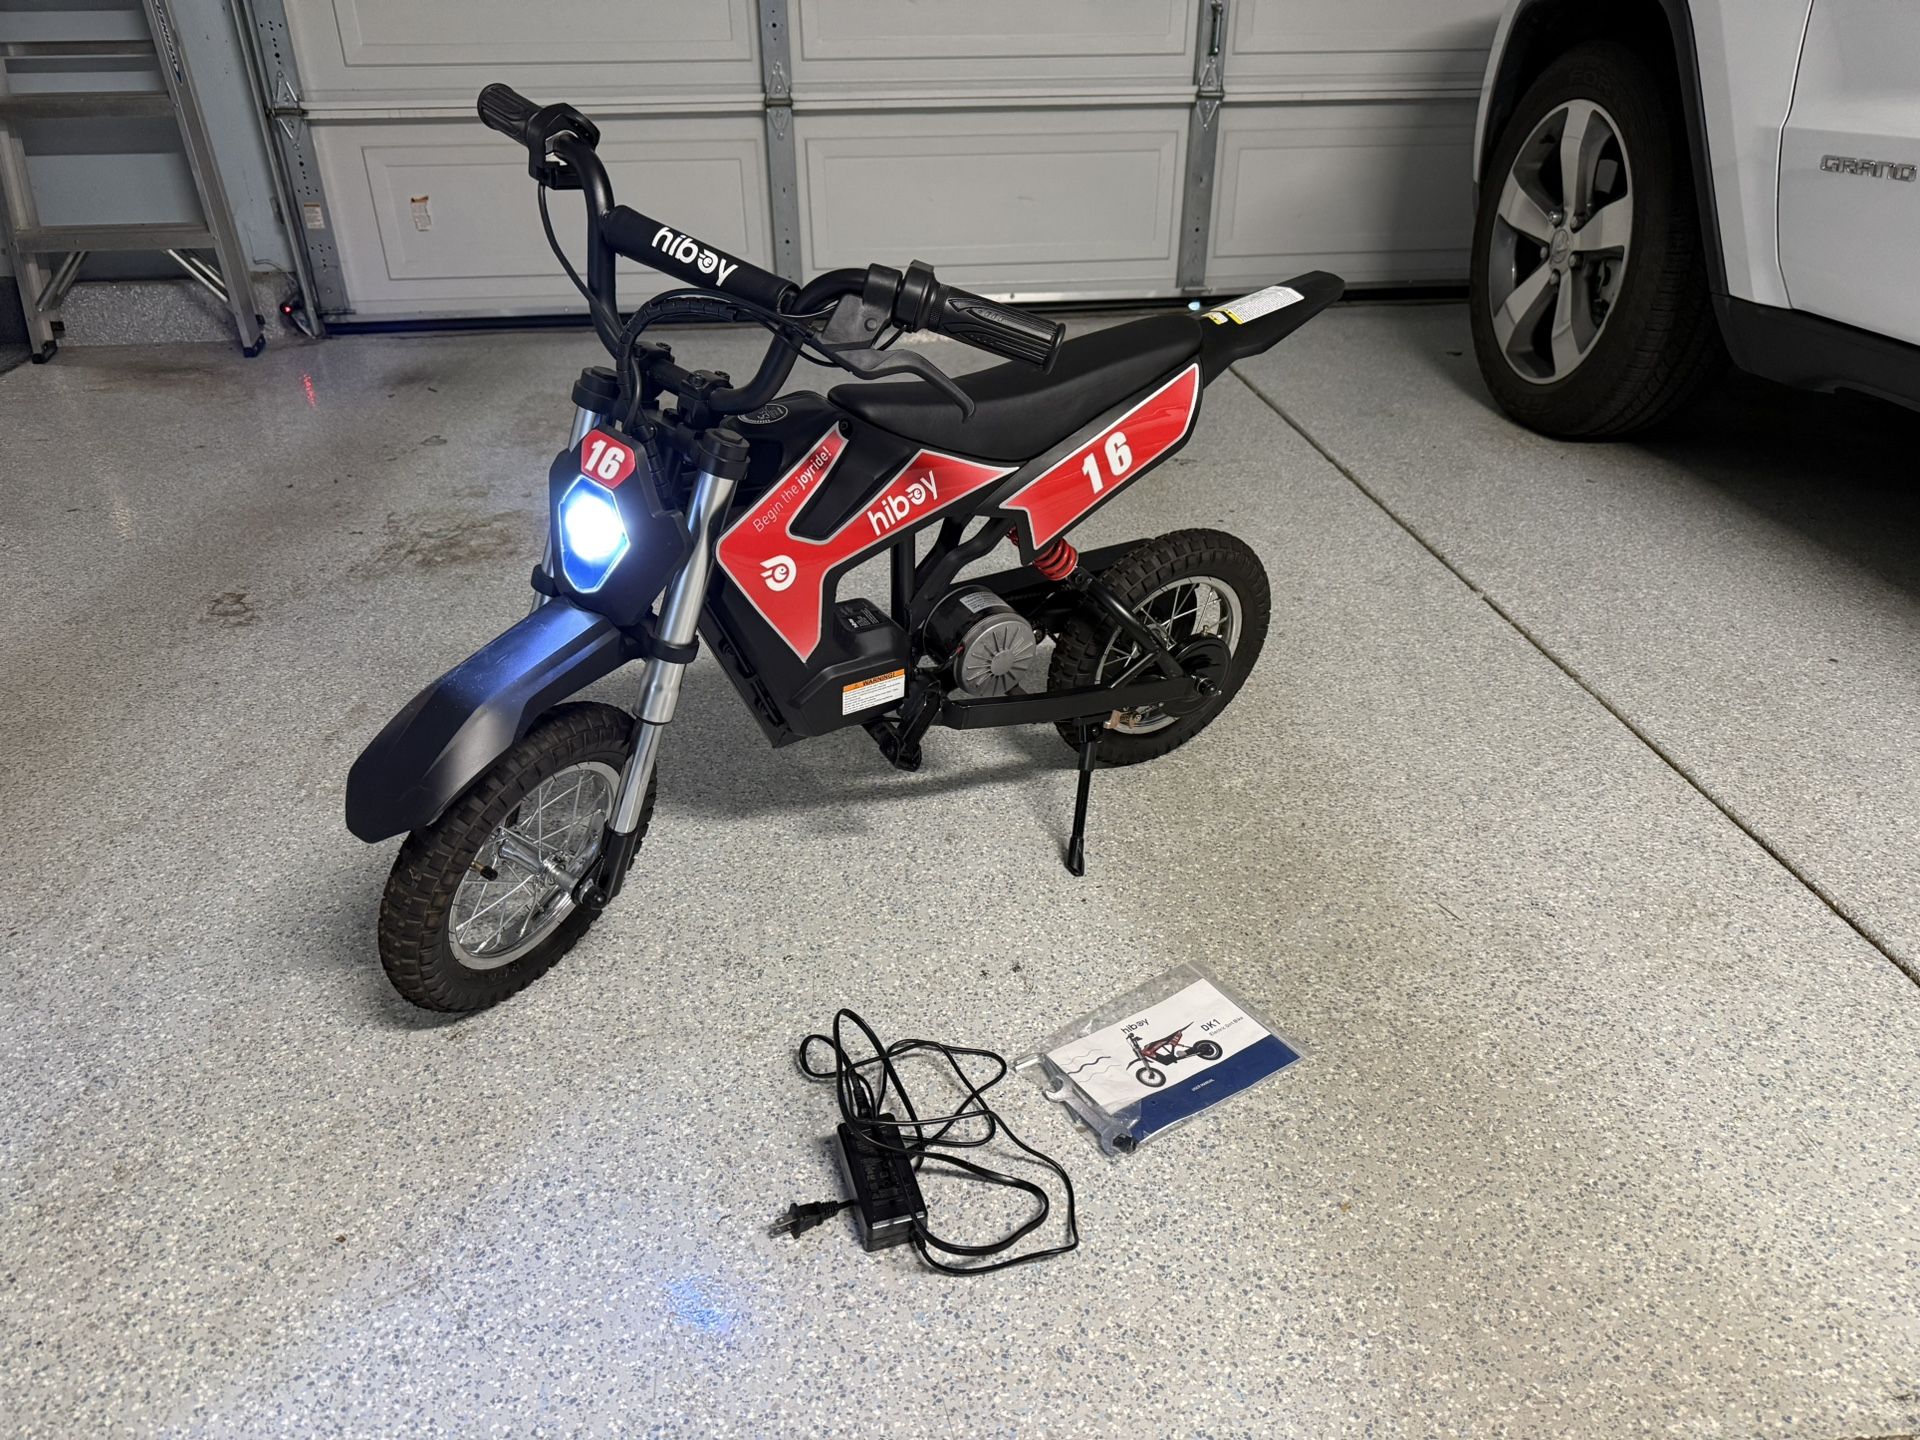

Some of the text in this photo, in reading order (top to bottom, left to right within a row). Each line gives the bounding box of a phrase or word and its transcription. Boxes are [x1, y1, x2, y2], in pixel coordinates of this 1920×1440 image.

[1820, 155, 1917, 182] GRAND
[651, 226, 739, 287] hiboy
[585, 439, 626, 480] 16
[752, 445, 832, 533] Begin the joyride!
[1081, 431, 1133, 495] 16
[866, 470, 938, 537] hiboy
[1200, 1018, 1221, 1032] DK1
